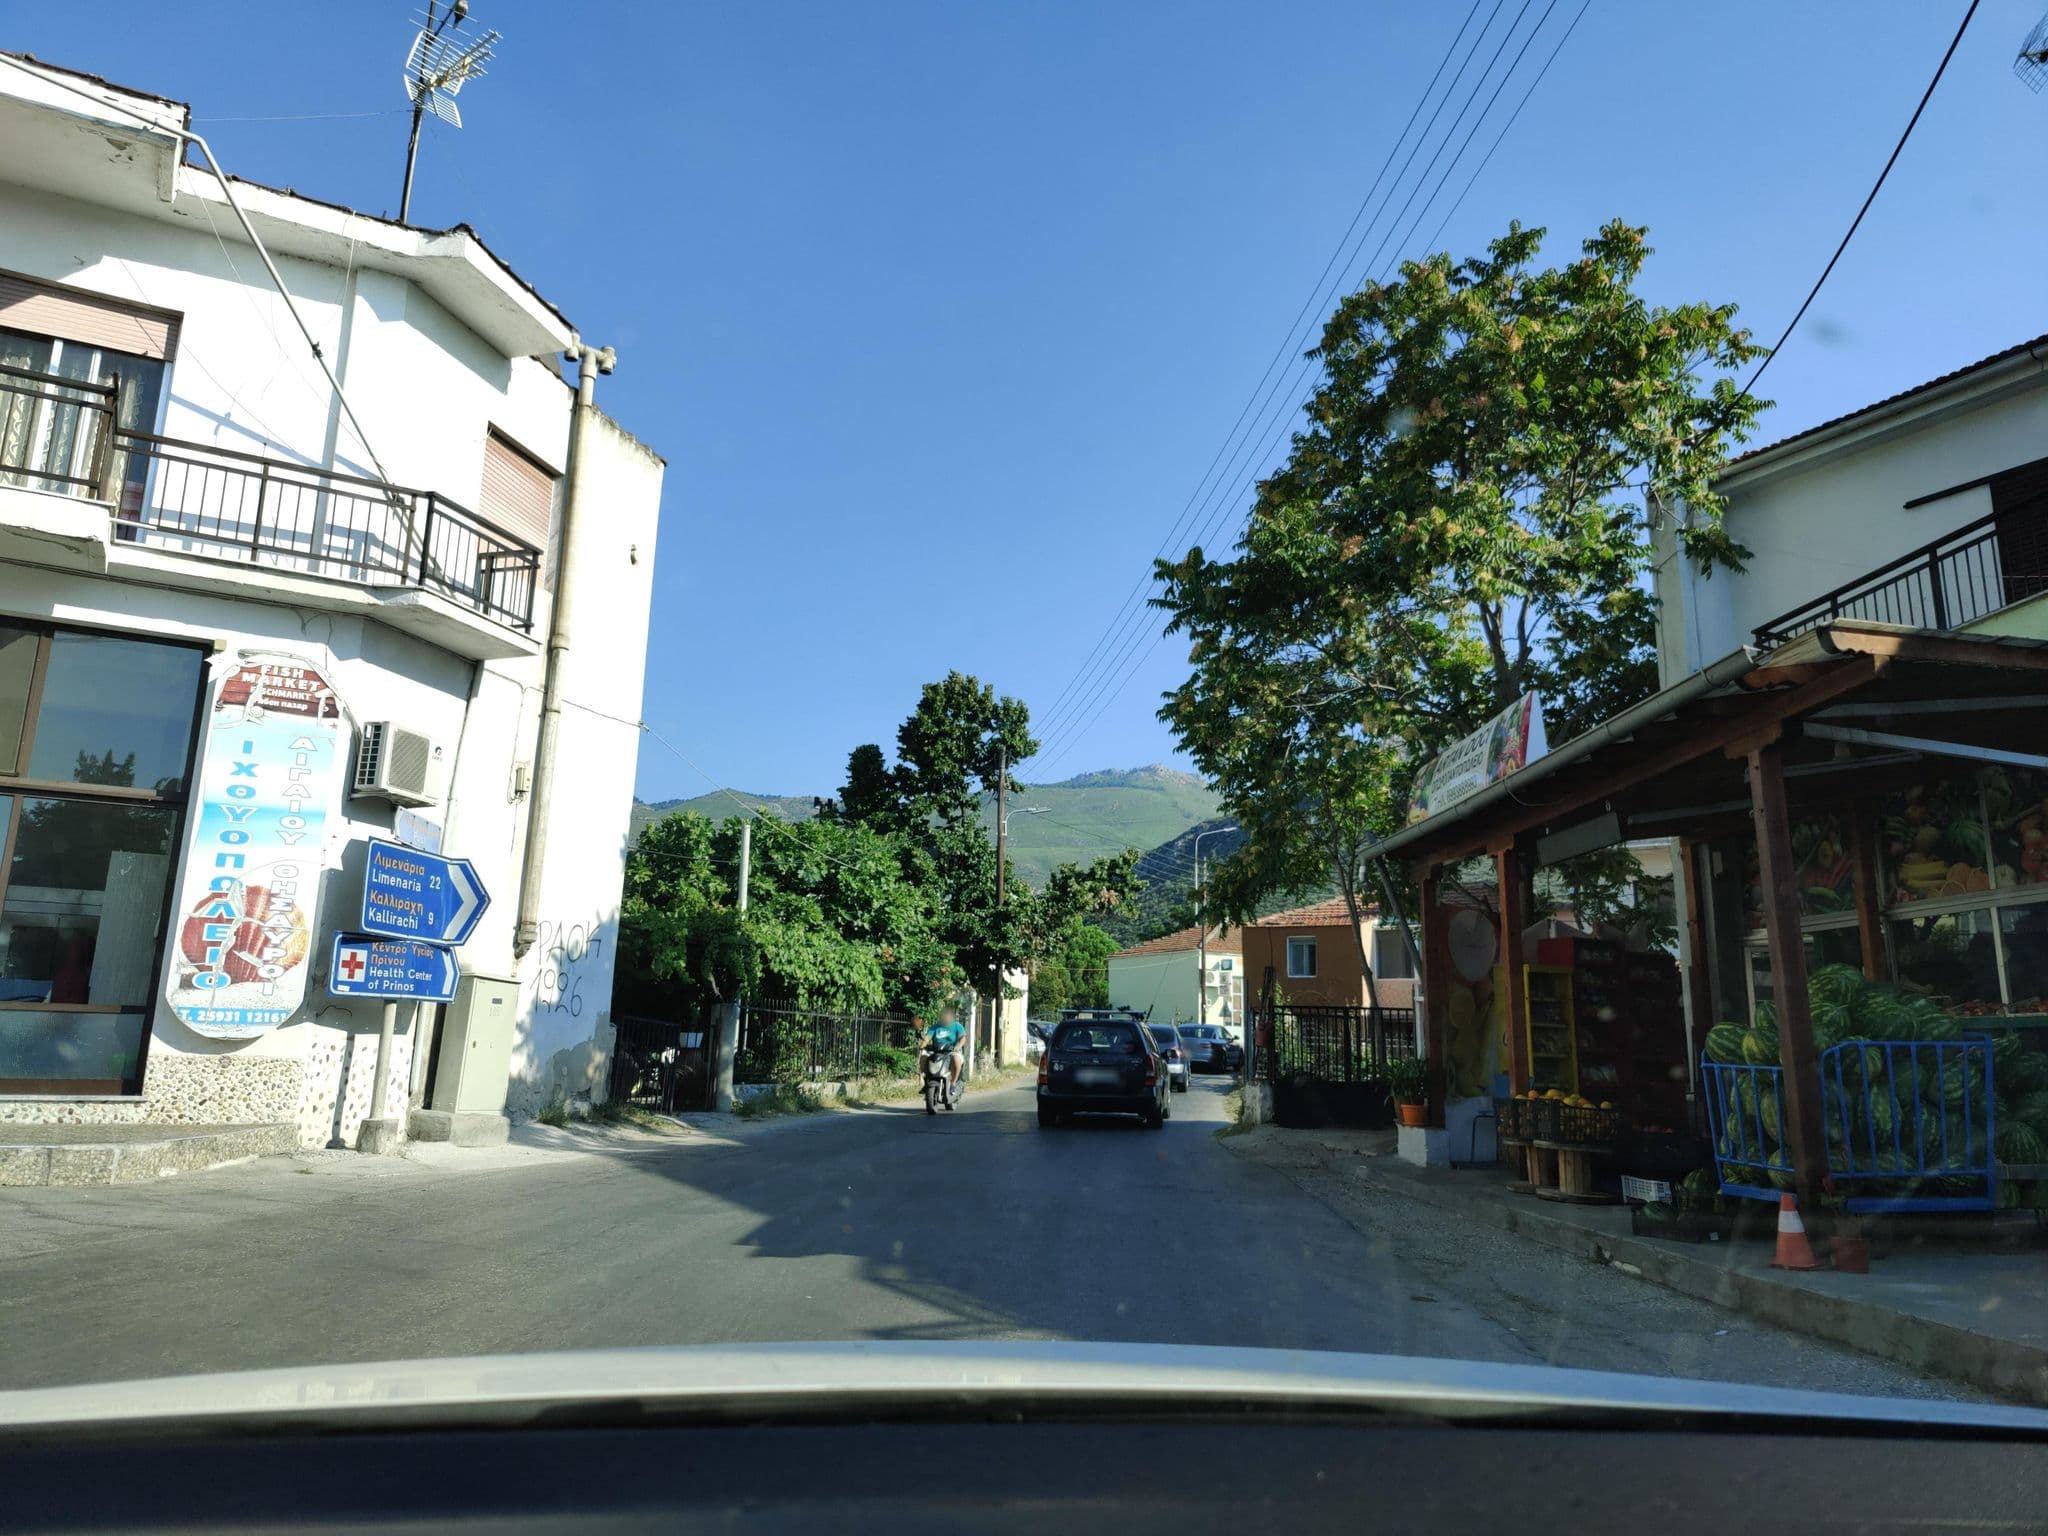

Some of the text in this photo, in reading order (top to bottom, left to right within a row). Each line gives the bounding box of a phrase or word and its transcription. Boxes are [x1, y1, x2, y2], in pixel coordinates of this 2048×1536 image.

[261, 664, 304, 678] FISH
[242, 672, 320, 691] MARKET
[250, 685, 312, 700] FSCHMARKT
[275, 737, 317, 845] ΑΙΓΑΙΟΥ
[374, 851, 425, 876] Λιμενάρια
[372, 868, 441, 892] Limenaria 22
[370, 889, 424, 916] Καλλιράχη
[368, 907, 434, 929] Kallirachi 9
[371, 942, 434, 959] Κέντρο Υγείας
[371, 954, 406, 967] Πρίνου
[369, 966, 432, 981] Health Center
[368, 980, 415, 991] of Prinos
[197, 1009, 240, 1022] 25931
[247, 1011, 286, 1023] 12161
